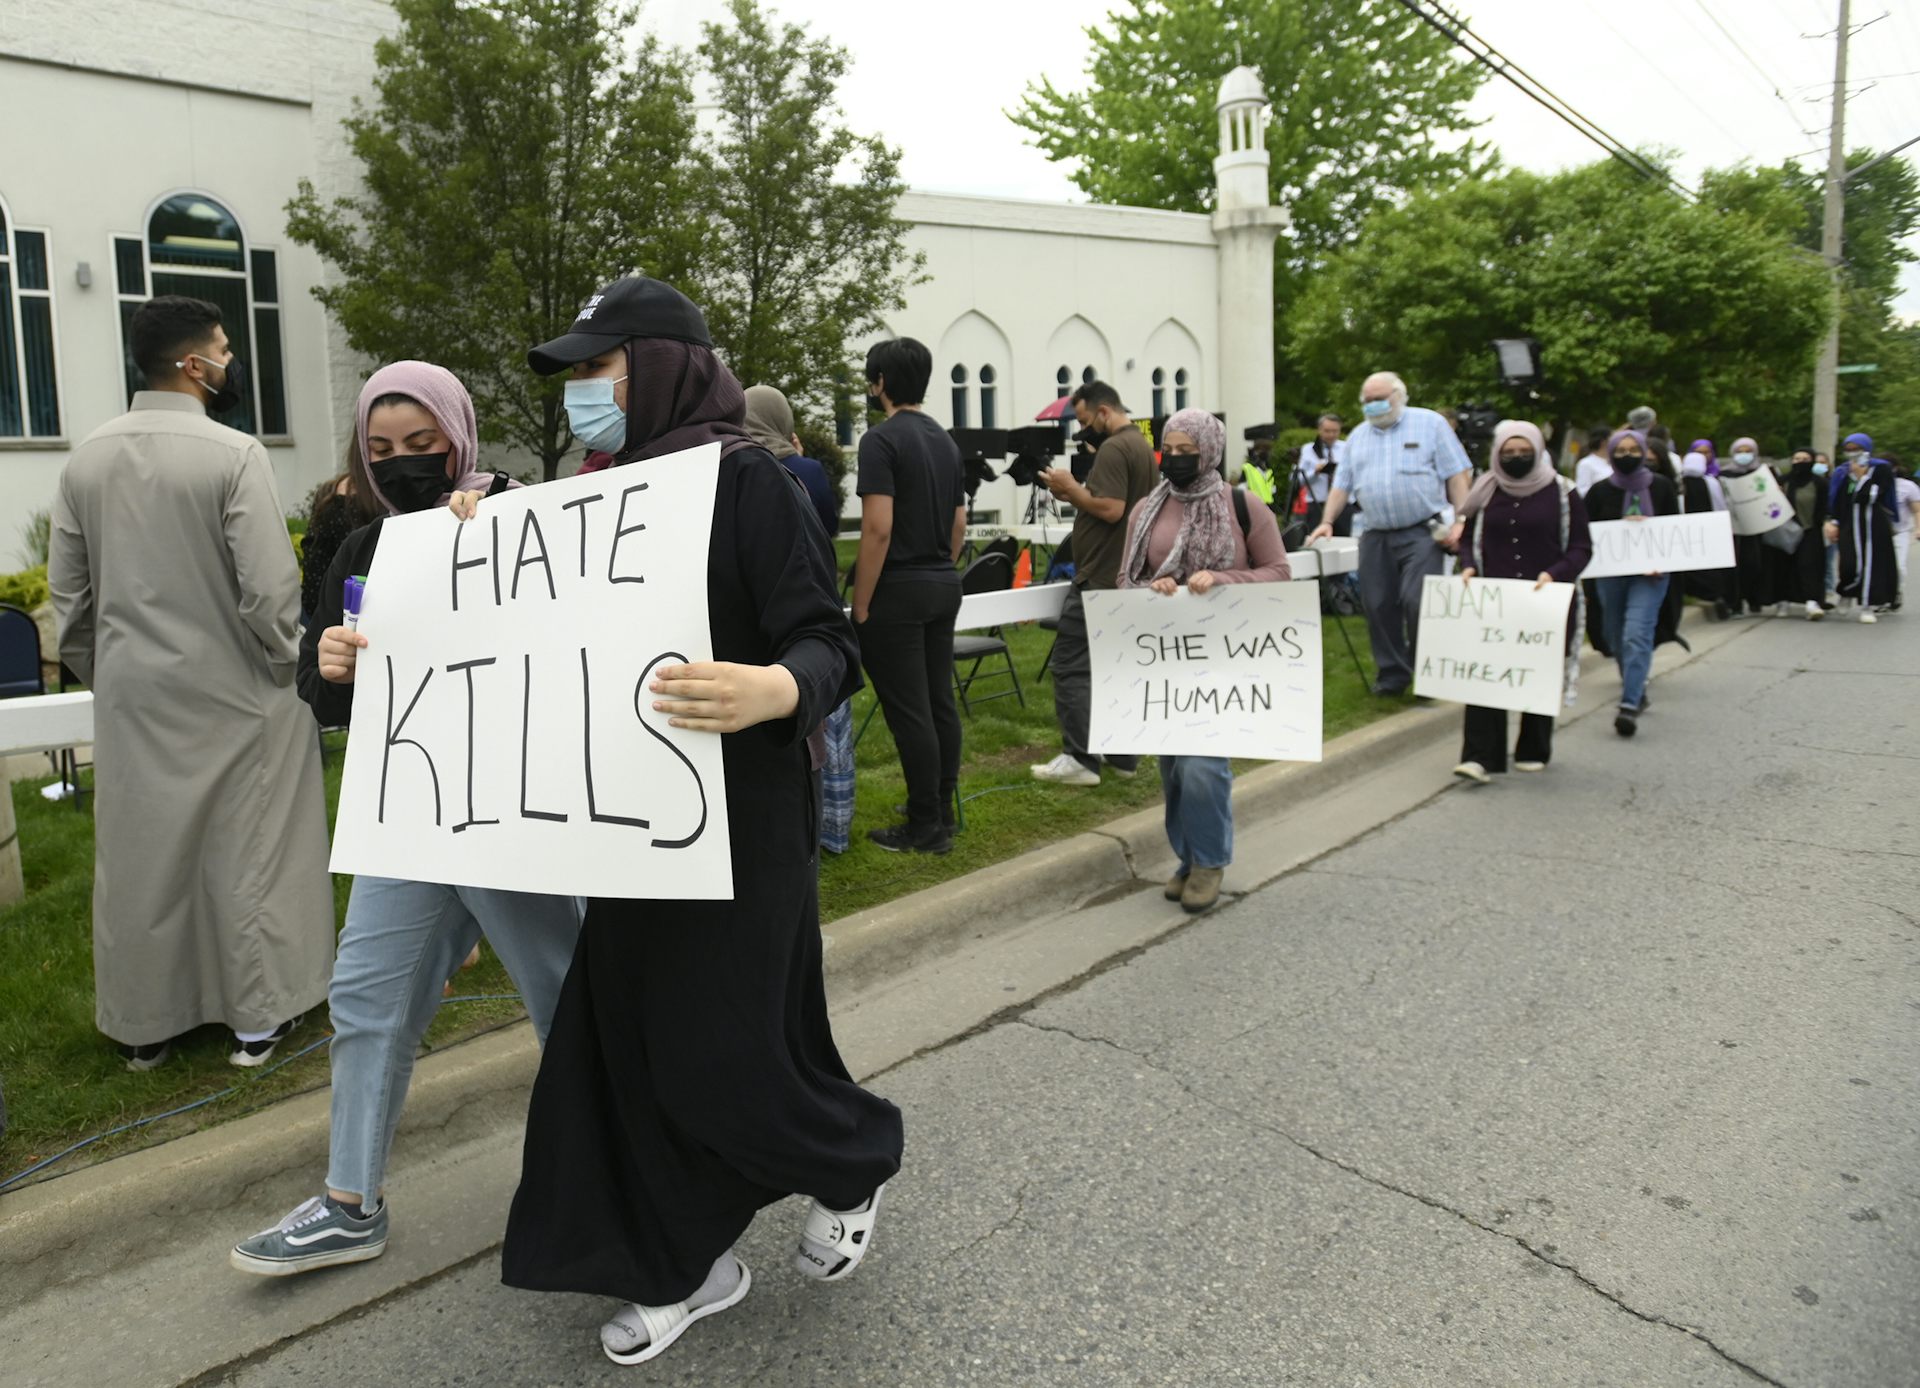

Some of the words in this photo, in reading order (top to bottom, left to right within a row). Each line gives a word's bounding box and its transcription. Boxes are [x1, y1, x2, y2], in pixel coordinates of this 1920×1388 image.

[451, 482, 649, 612] HATE
[1421, 579, 1504, 621] ISLAM
[1136, 633, 1209, 667] SHE
[1223, 625, 1304, 660] WAS
[1481, 626, 1505, 643] IS
[1516, 630, 1556, 647] NOT
[1142, 678, 1272, 721] HUMAN
[378, 647, 708, 849] KILLS
